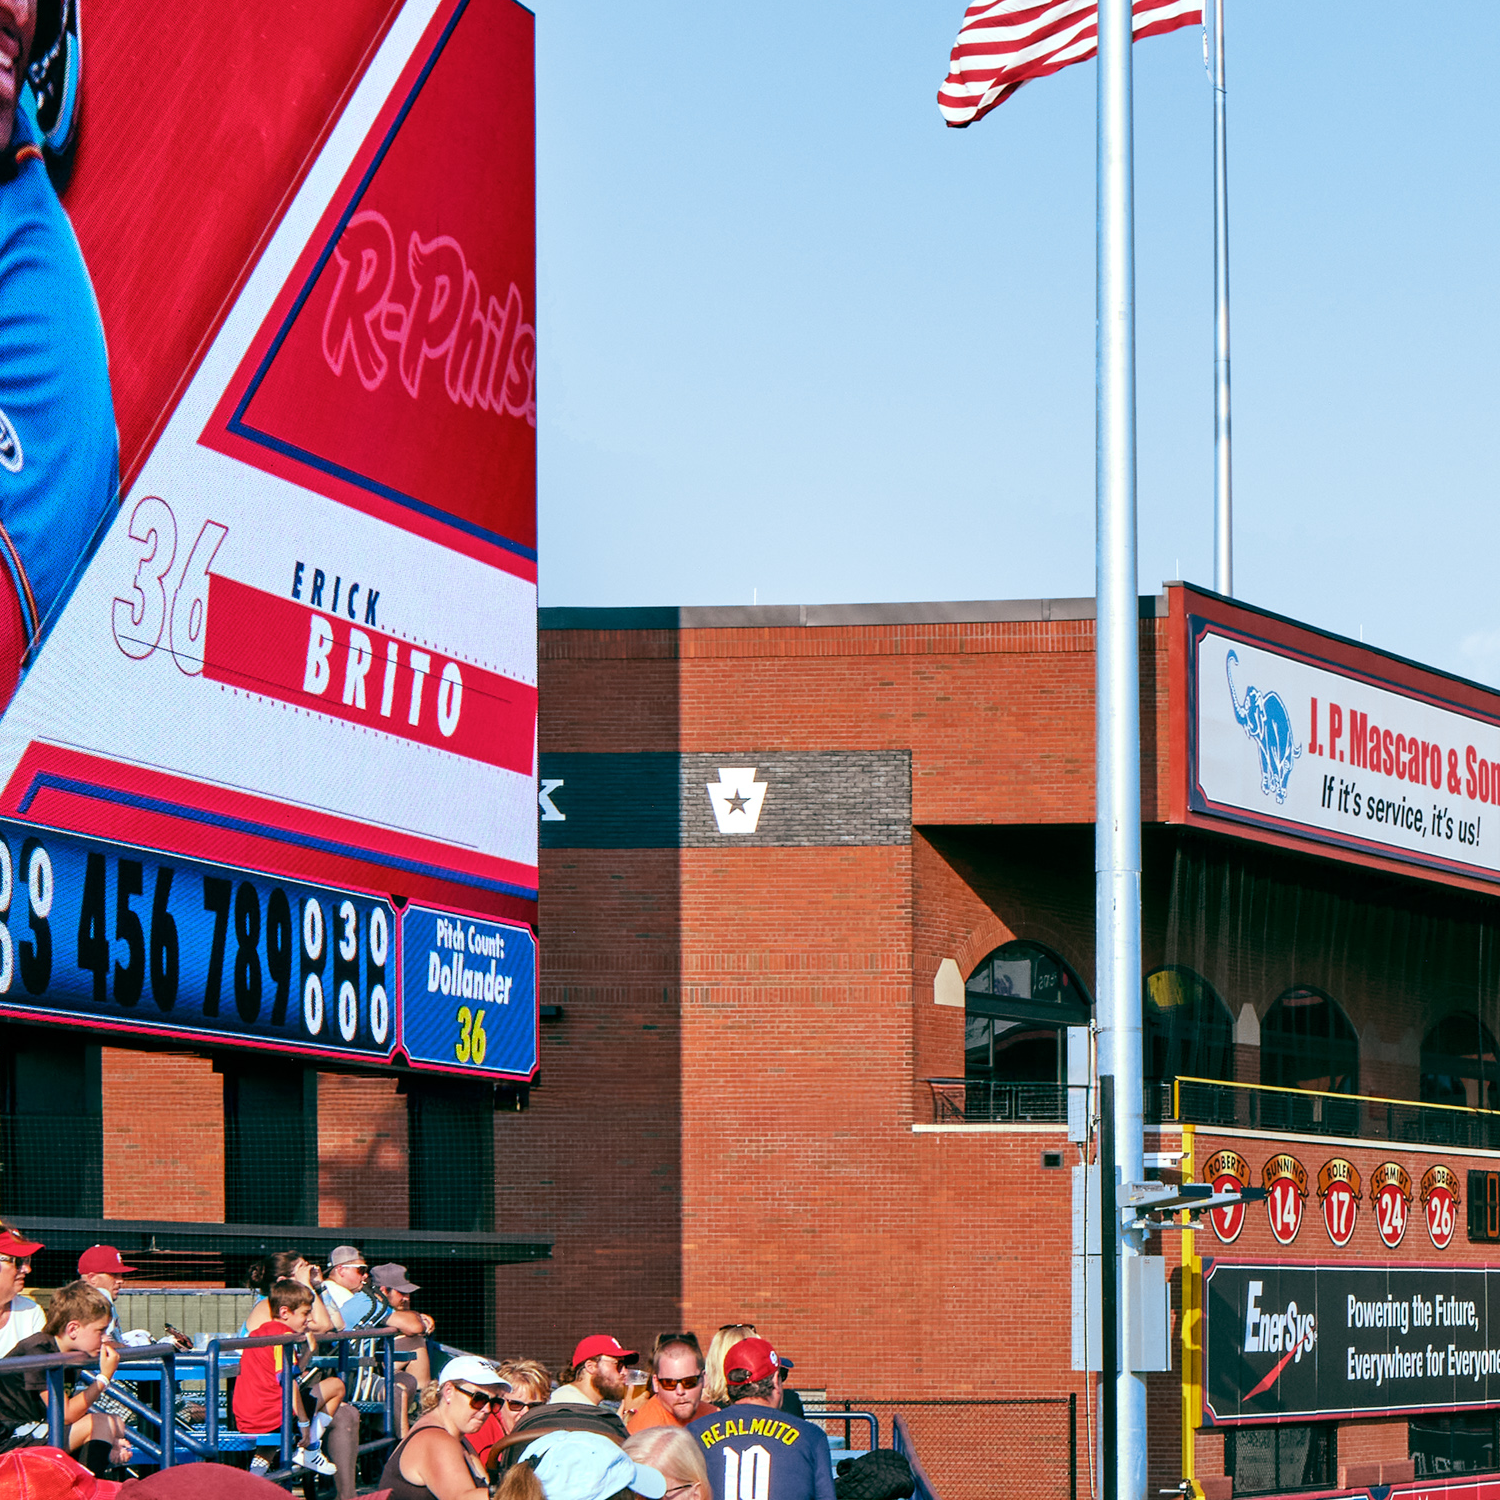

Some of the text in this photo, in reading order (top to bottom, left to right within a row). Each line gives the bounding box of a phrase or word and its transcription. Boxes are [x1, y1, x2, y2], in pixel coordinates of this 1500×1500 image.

[111, 497, 228, 677] 36
[292, 561, 379, 627] ERICK
[303, 614, 463, 736] BRITO
[1308, 697, 1323, 756] J.
[1329, 702, 1344, 763] P.
[1349, 707, 1442, 790] Mascaro
[1447, 747, 1461, 793] &
[1321, 775, 1481, 846] If it's service, it's us!
[436, 918, 505, 959] Pitch Count:
[427, 952, 512, 1005] Dollander
[455, 1006, 487, 1064] 36
[1209, 1160, 1246, 1177] ROBERTS
[1266, 1162, 1304, 1185] BUNNING
[1327, 1164, 1352, 1179] ROLEN
[1375, 1168, 1408, 1188] SCHMIDT
[1422, 1171, 1458, 1193] SANDBERG
[1275, 1186, 1296, 1232] 14
[1331, 1192, 1349, 1234] 17
[1382, 1193, 1402, 1235] 24
[1432, 1197, 1450, 1235] 26
[1347, 1294, 1479, 1336] Powering the Future,
[1347, 1347, 1423, 1388] Everywhere
[1425, 1347, 1443, 1377] for
[700, 1418, 800, 1449] REALMUTO
